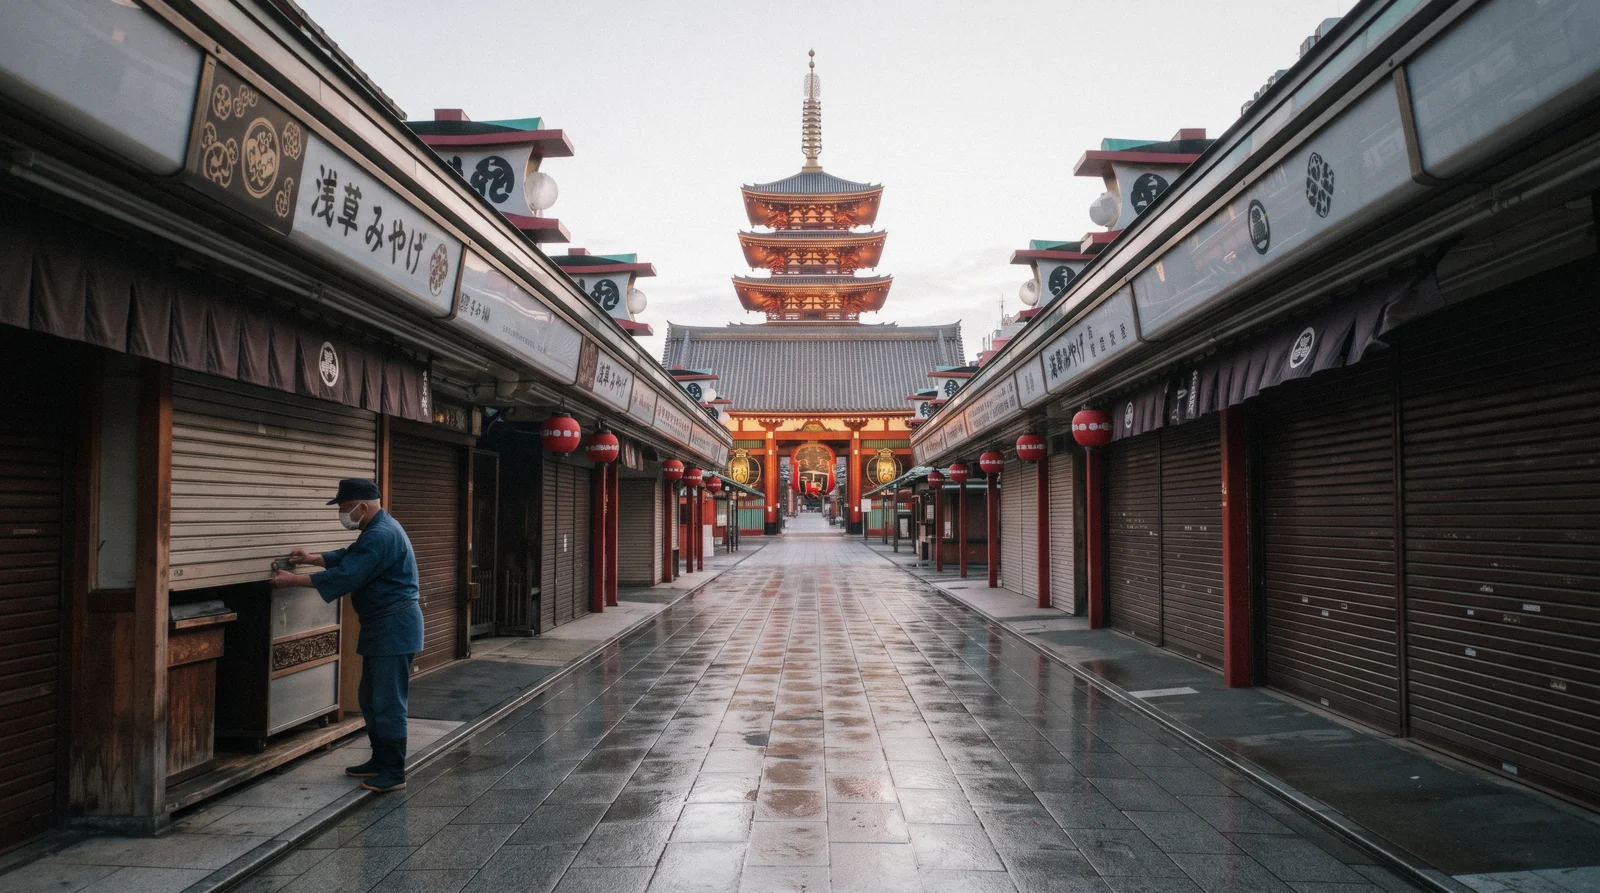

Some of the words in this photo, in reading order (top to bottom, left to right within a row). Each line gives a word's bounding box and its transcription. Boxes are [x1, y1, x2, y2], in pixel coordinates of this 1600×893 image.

[311, 164, 427, 275] 浅草みやげ
